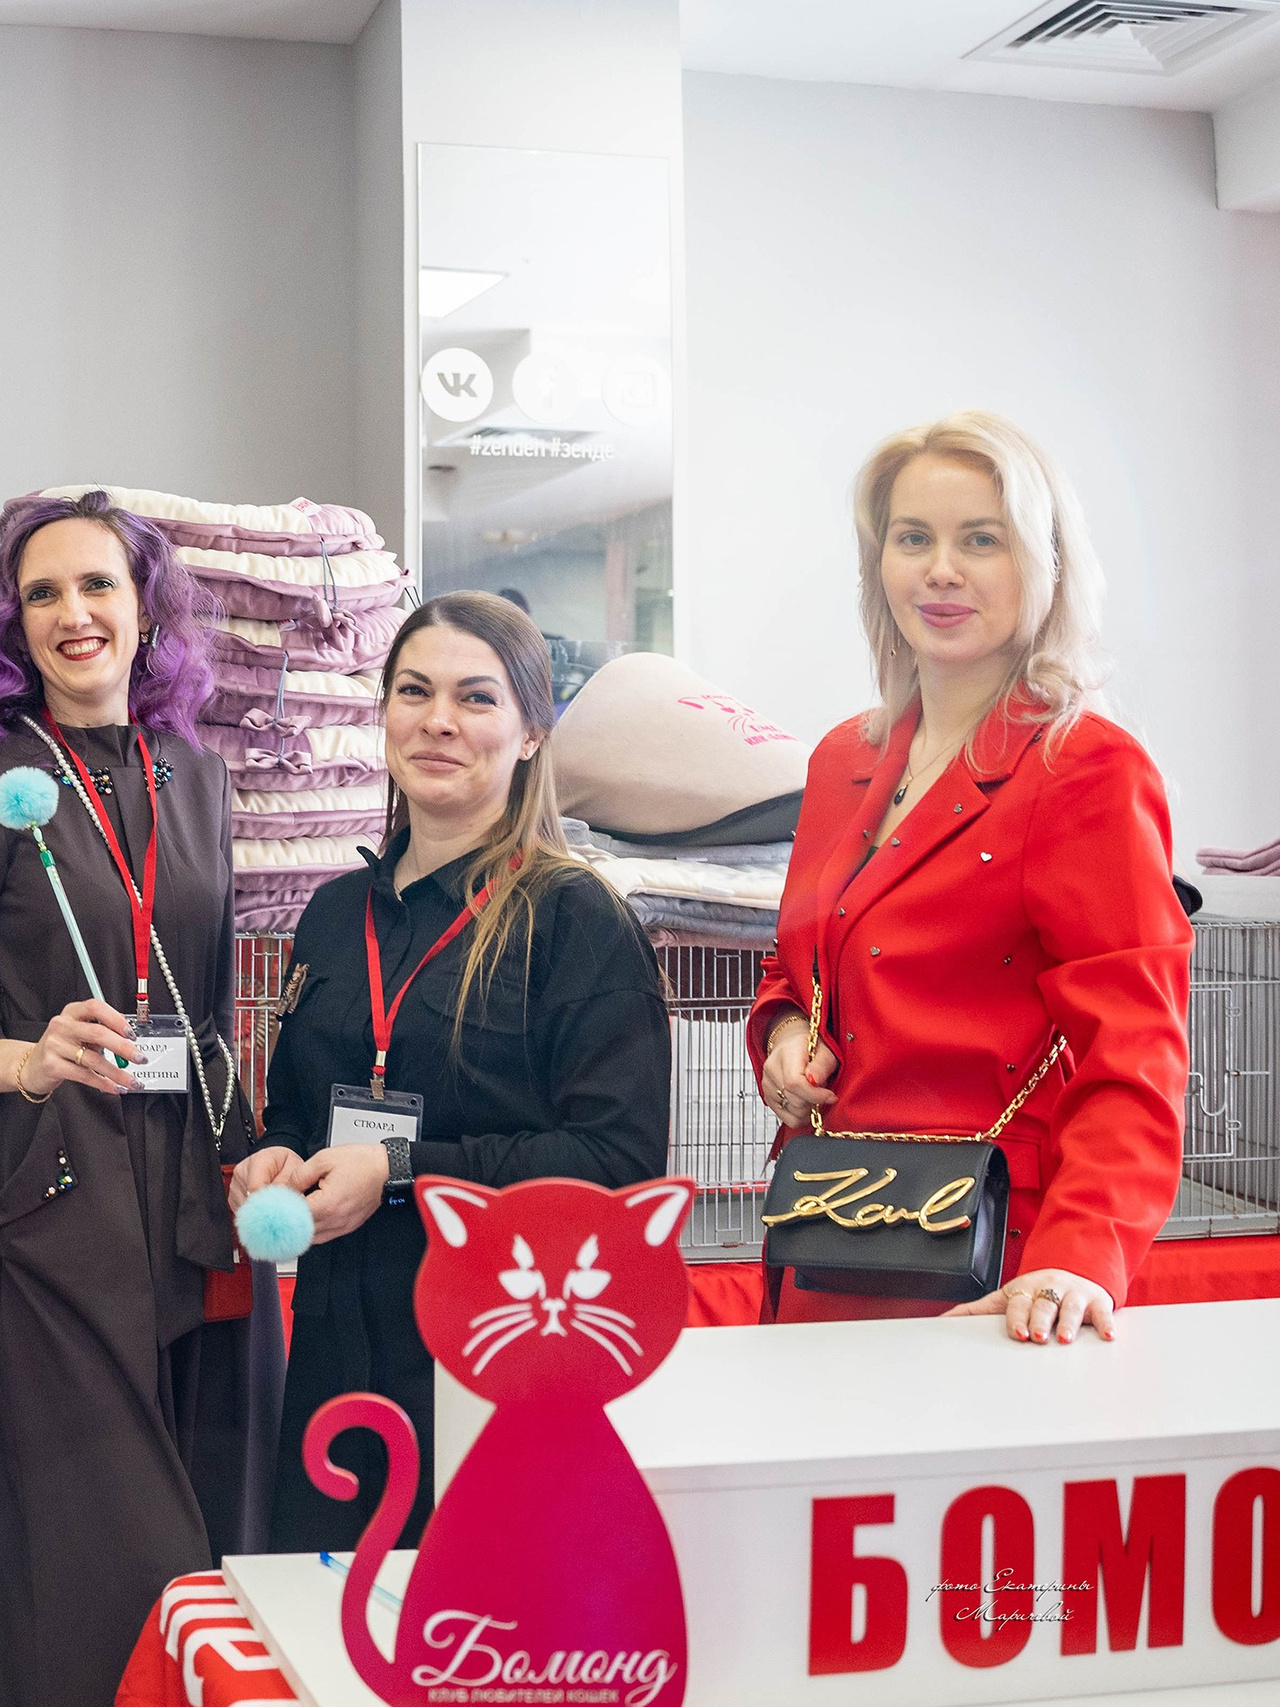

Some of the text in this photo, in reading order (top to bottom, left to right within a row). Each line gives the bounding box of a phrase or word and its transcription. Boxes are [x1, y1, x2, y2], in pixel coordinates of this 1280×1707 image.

[437, 372, 477, 398] VK
[470, 435, 545, 457] #zenden
[135, 1044, 168, 1054] ЮАРД
[133, 1070, 180, 1079] ентина
[353, 1119, 396, 1132] СТЮАРД
[761, 1167, 976, 1234] Karl
[411, 1609, 678, 1707] Бомонд
[428, 1687, 620, 1704] КЛУБ ЛЮБИТЕЛЕЙ КОШЕК
